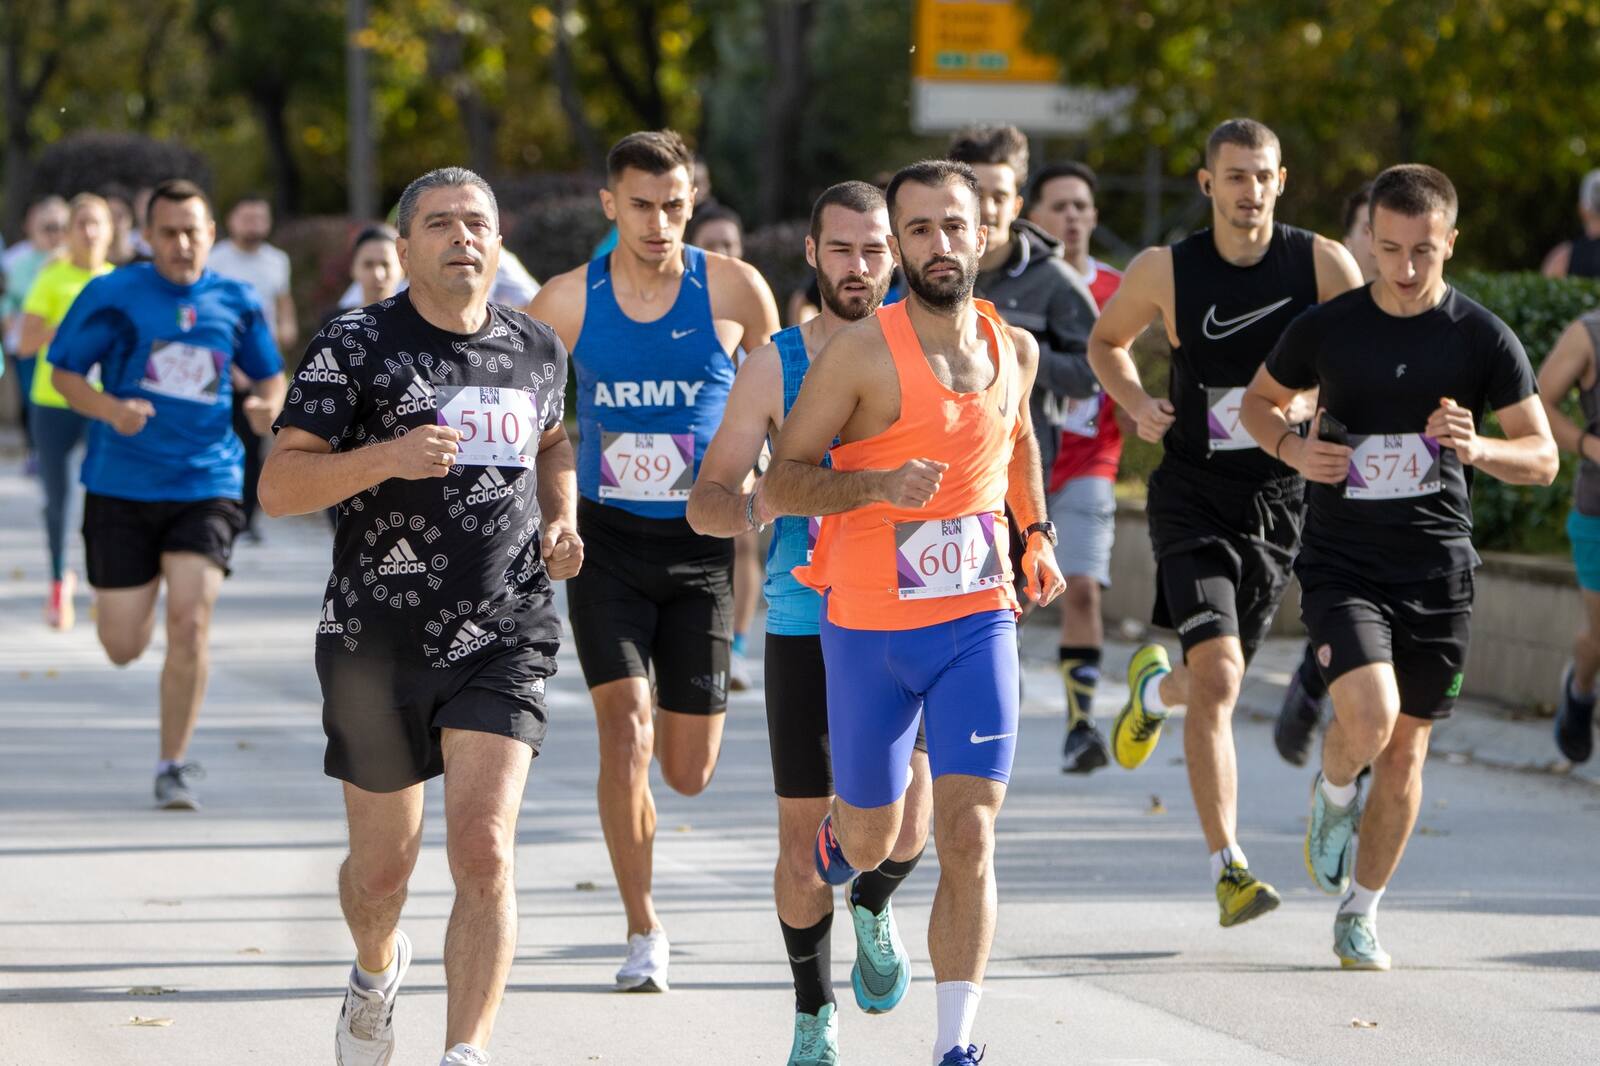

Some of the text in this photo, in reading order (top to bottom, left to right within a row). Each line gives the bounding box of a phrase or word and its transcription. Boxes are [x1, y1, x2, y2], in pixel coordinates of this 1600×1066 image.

[299, 369, 348, 385] adidas
[479, 395, 501, 406] RUN
[594, 380, 704, 408] ARMY
[460, 410, 520, 445] 510
[617, 453, 671, 482] 789
[1365, 453, 1421, 482] 574
[466, 484, 513, 505] adidas
[365, 512, 441, 546] BADGE
[941, 526, 962, 536] RUN
[378, 560, 427, 576] adidas
[919, 539, 978, 576] 604
[447, 630, 498, 662] adidas
